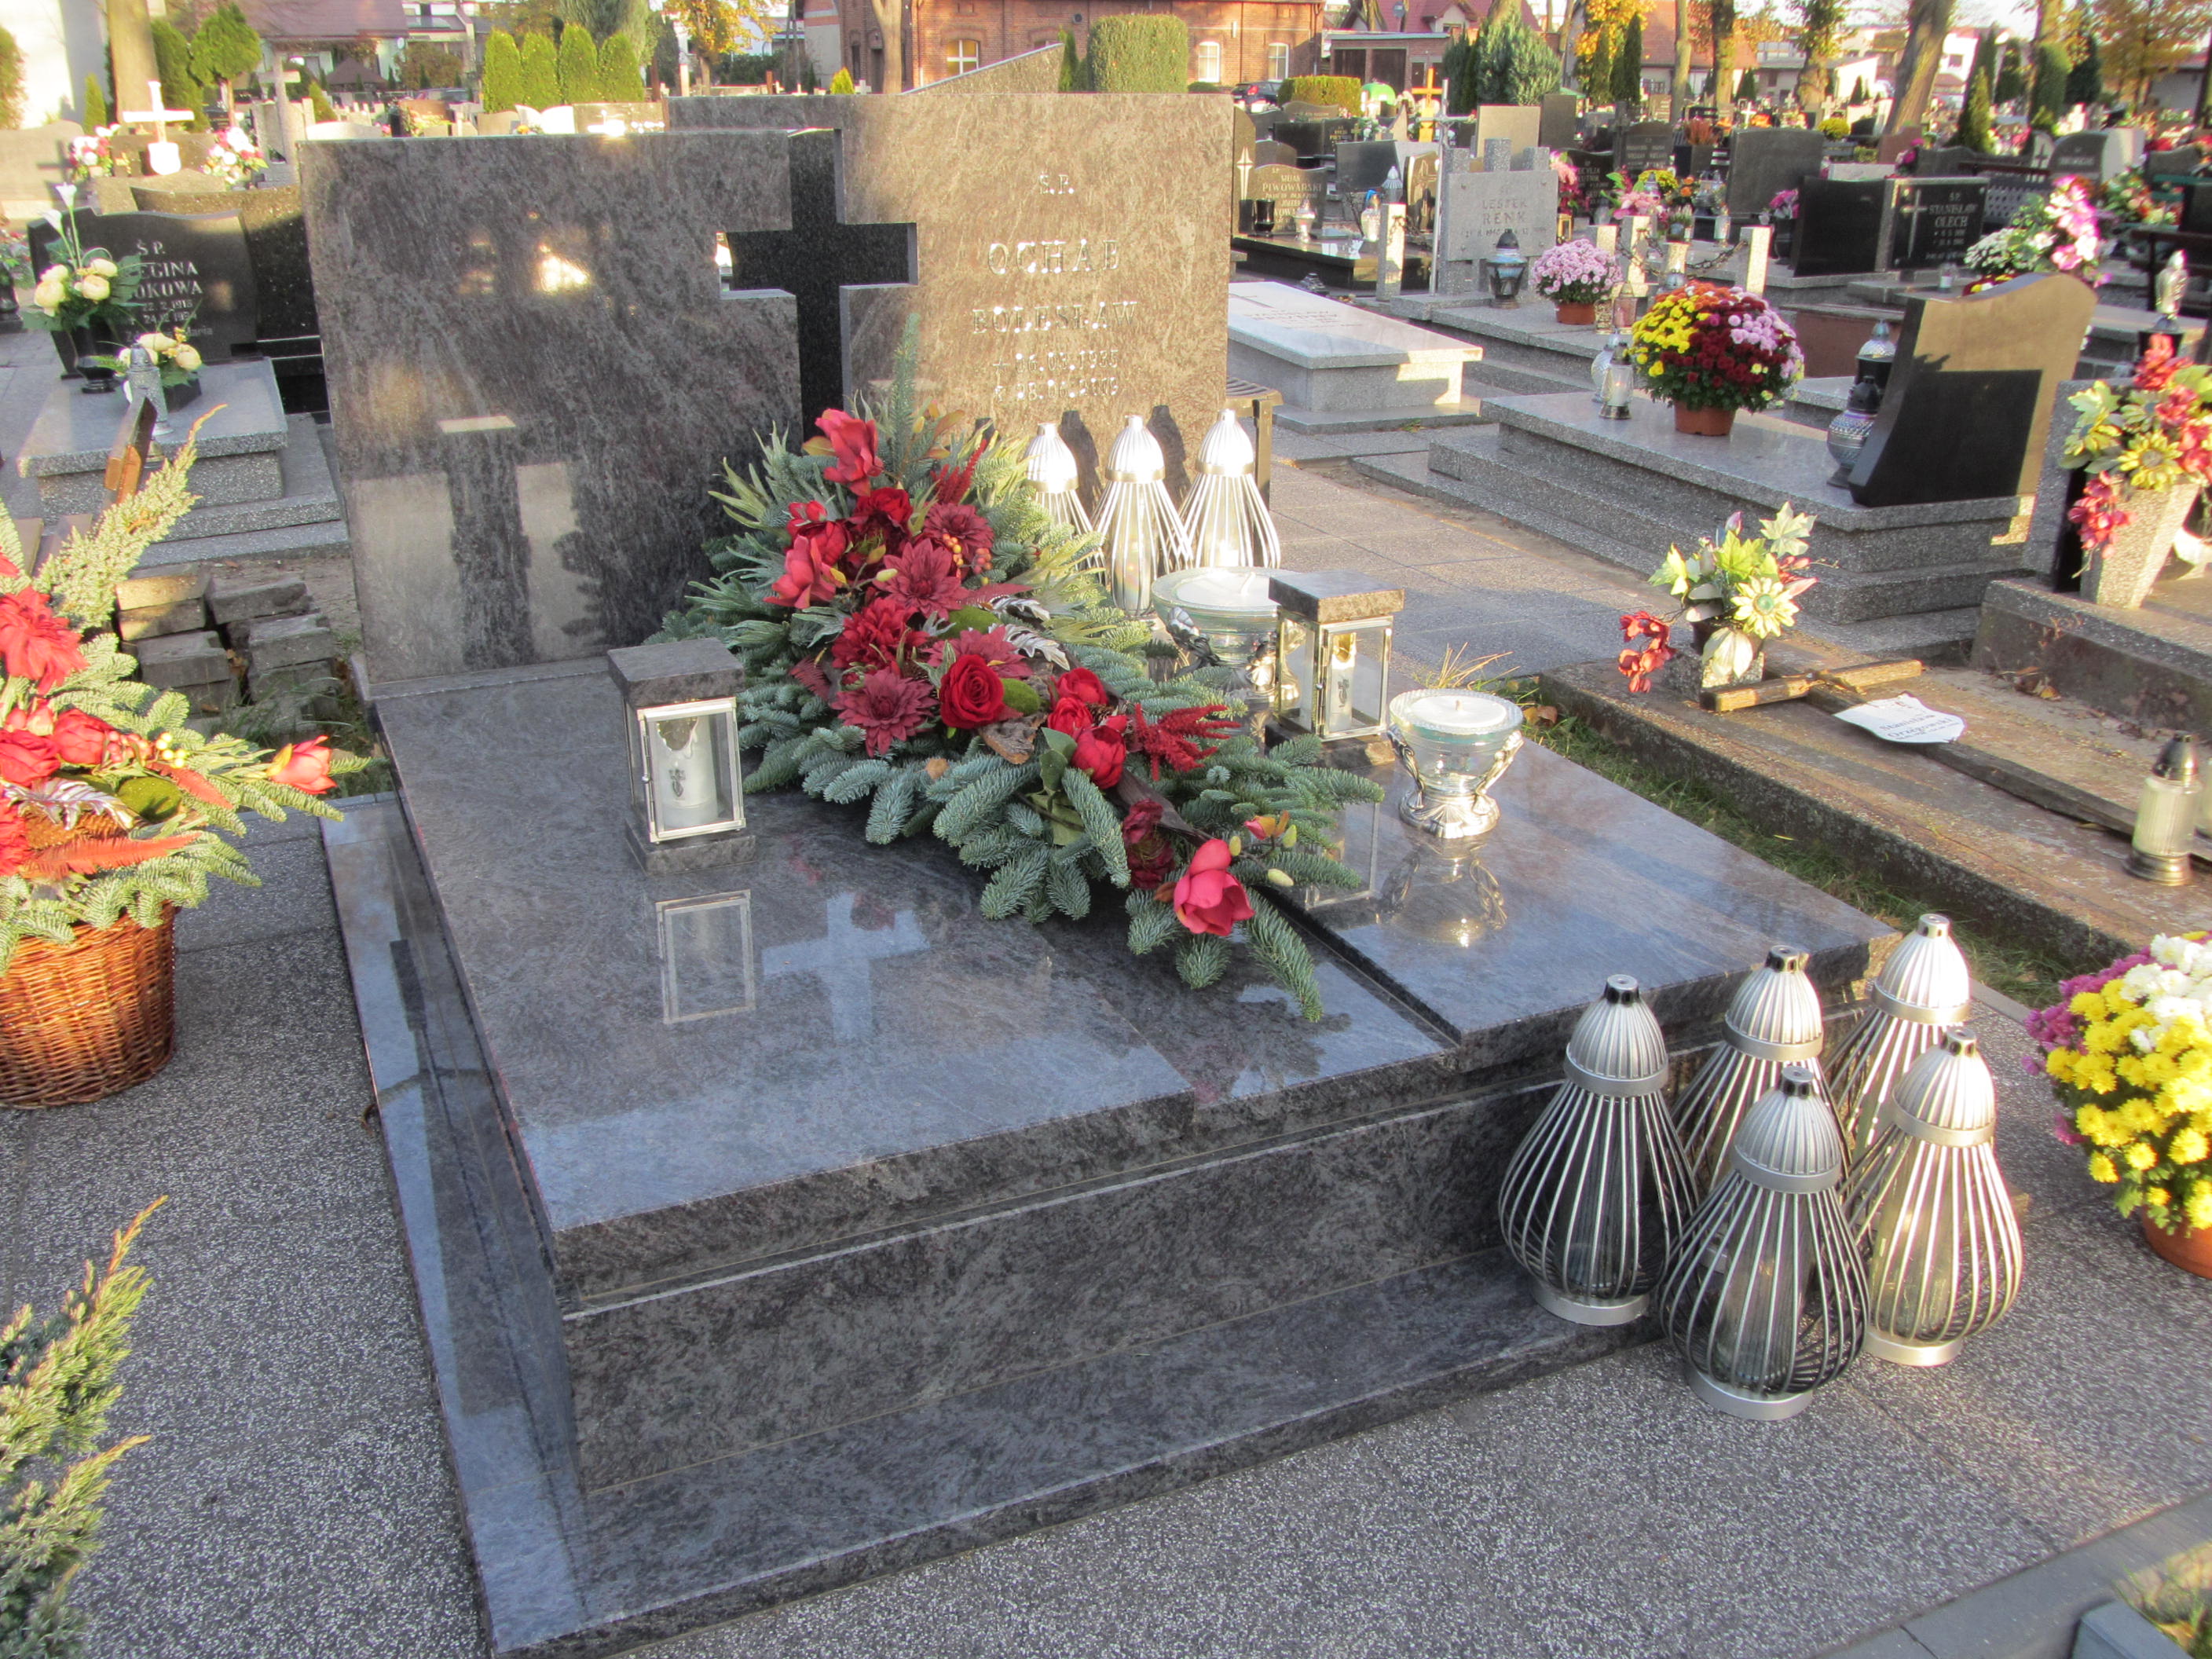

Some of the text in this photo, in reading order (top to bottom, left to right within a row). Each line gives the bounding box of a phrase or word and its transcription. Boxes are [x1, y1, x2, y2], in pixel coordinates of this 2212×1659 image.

[1482, 211, 1525, 225] RENK
[988, 238, 1120, 275] OCHAB
[141, 262, 199, 280] EGINA
[972, 300, 1137, 334] BOLESŁAW
